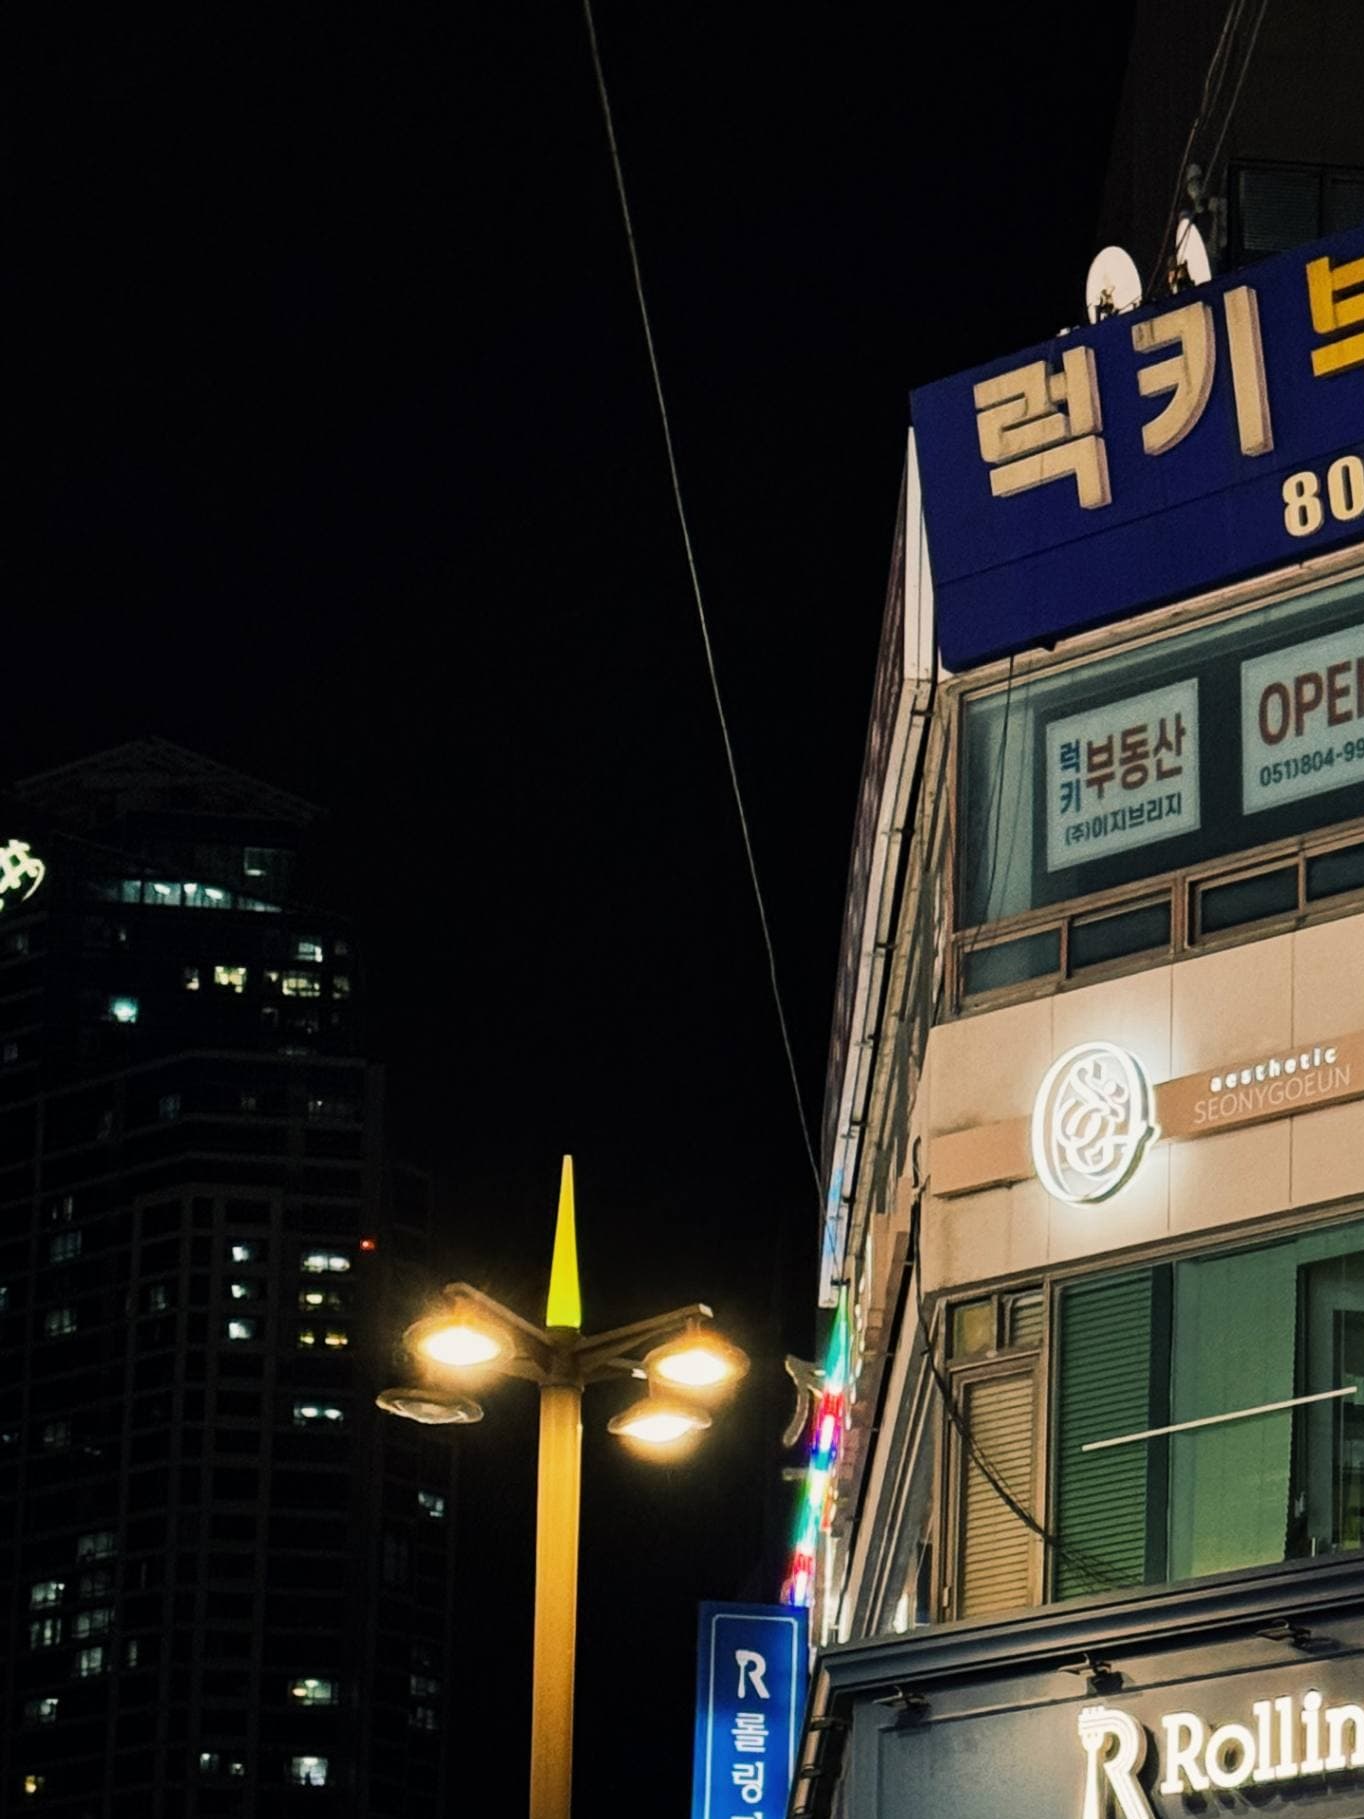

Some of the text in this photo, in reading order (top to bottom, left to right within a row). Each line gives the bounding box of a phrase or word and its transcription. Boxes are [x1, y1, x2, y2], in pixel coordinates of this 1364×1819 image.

[1085, 711, 1187, 800] 부동산
[1065, 791, 1183, 848] (주)이지브리지
[1194, 1064, 1352, 1126] SEONYGOEUN
[1208, 1046, 1338, 1094] aesthetic
